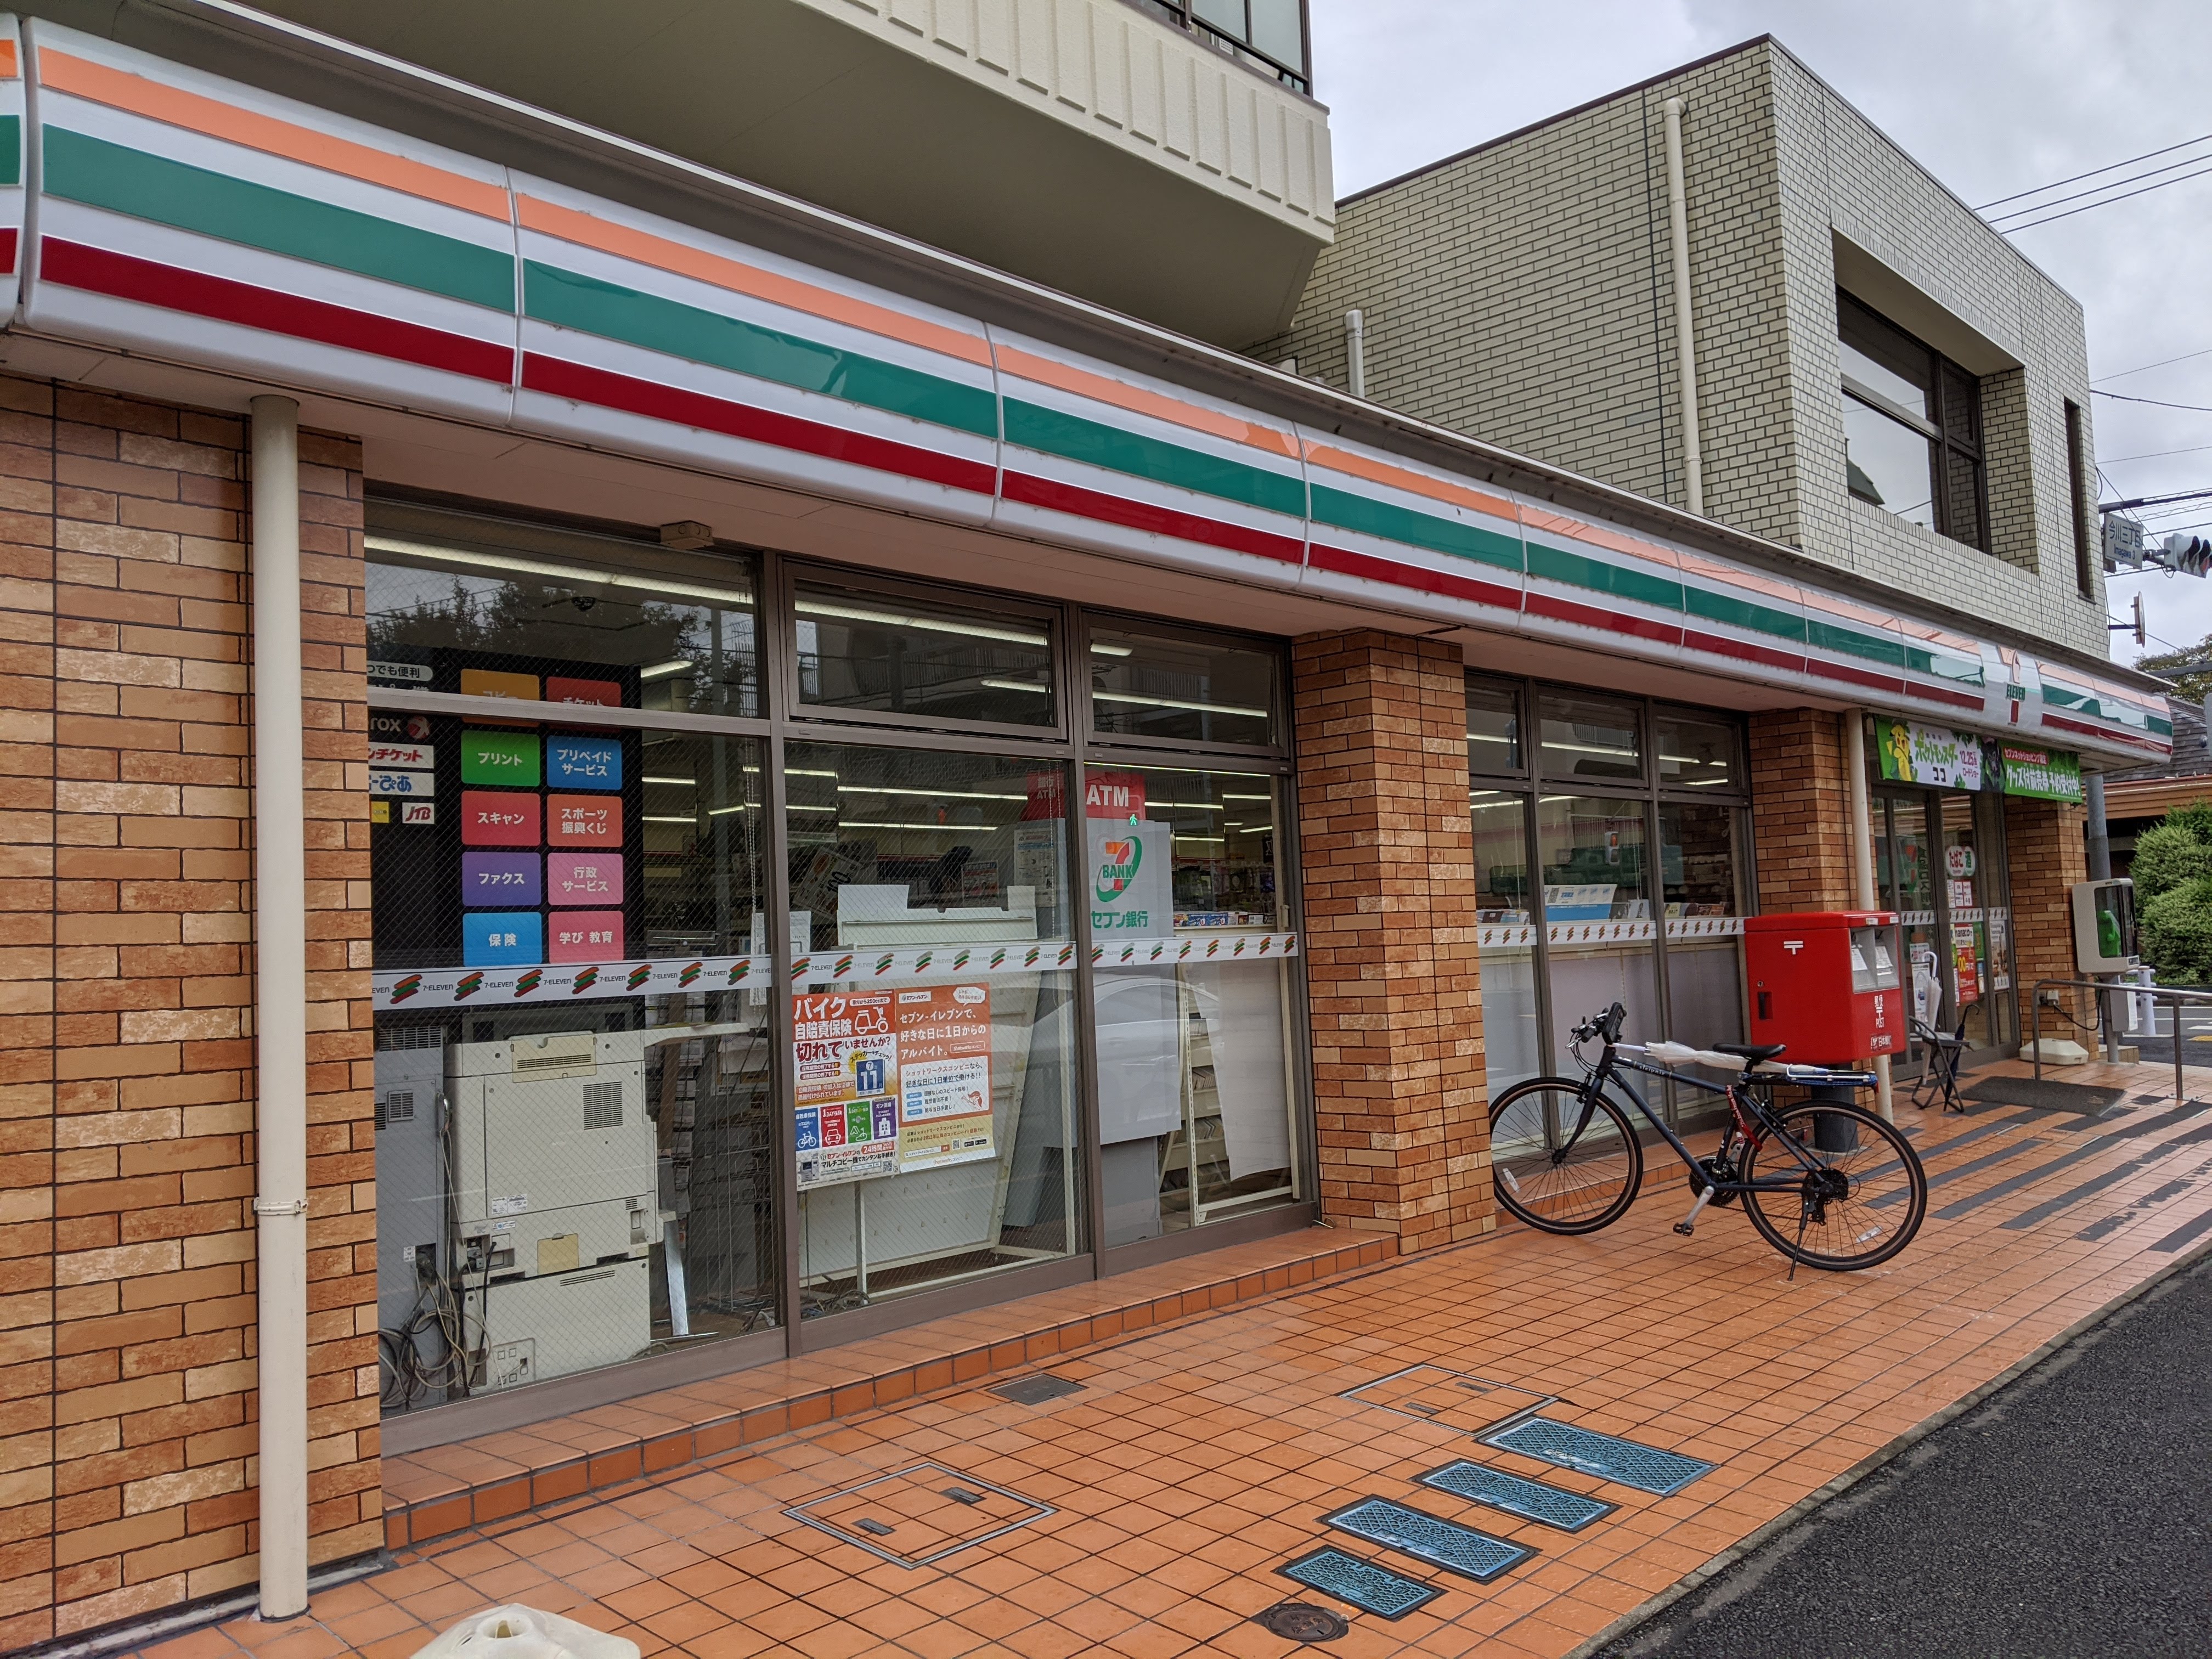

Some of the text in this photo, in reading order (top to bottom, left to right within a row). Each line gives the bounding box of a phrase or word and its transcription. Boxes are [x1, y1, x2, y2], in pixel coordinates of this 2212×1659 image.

[2109, 521, 2140, 547] 今川三丁目
[2114, 544, 2135, 560] Imagawa 3
[478, 752, 522, 766] プリント
[557, 749, 612, 763] プリペイド
[562, 763, 607, 776] サービス
[1933, 766, 1946, 782] ココ
[1037, 776, 1054, 788] 銀行
[1037, 789, 1056, 799] ATM
[1087, 785, 1128, 807] ATM
[405, 806, 431, 822] JTB
[477, 812, 524, 825] スキャン
[561, 808, 607, 820] スポーツ
[562, 822, 607, 834] 振興くじ
[574, 867, 597, 878] 行政
[1103, 864, 1133, 878] BANK
[478, 873, 524, 885] ファクス
[562, 881, 608, 892] サービス
[489, 933, 516, 947] 保険
[559, 931, 612, 944] 学び 教育
[794, 997, 846, 1020] バイク
[795, 1018, 852, 1040] 自賠責保険
[1876, 1017, 1884, 1029] POST
[900, 1025, 986, 1042] 好きな日に1日からの
[901, 1045, 947, 1060] アルバイト。
[906, 1062, 983, 1076] ショットワークスコンビニなら、
